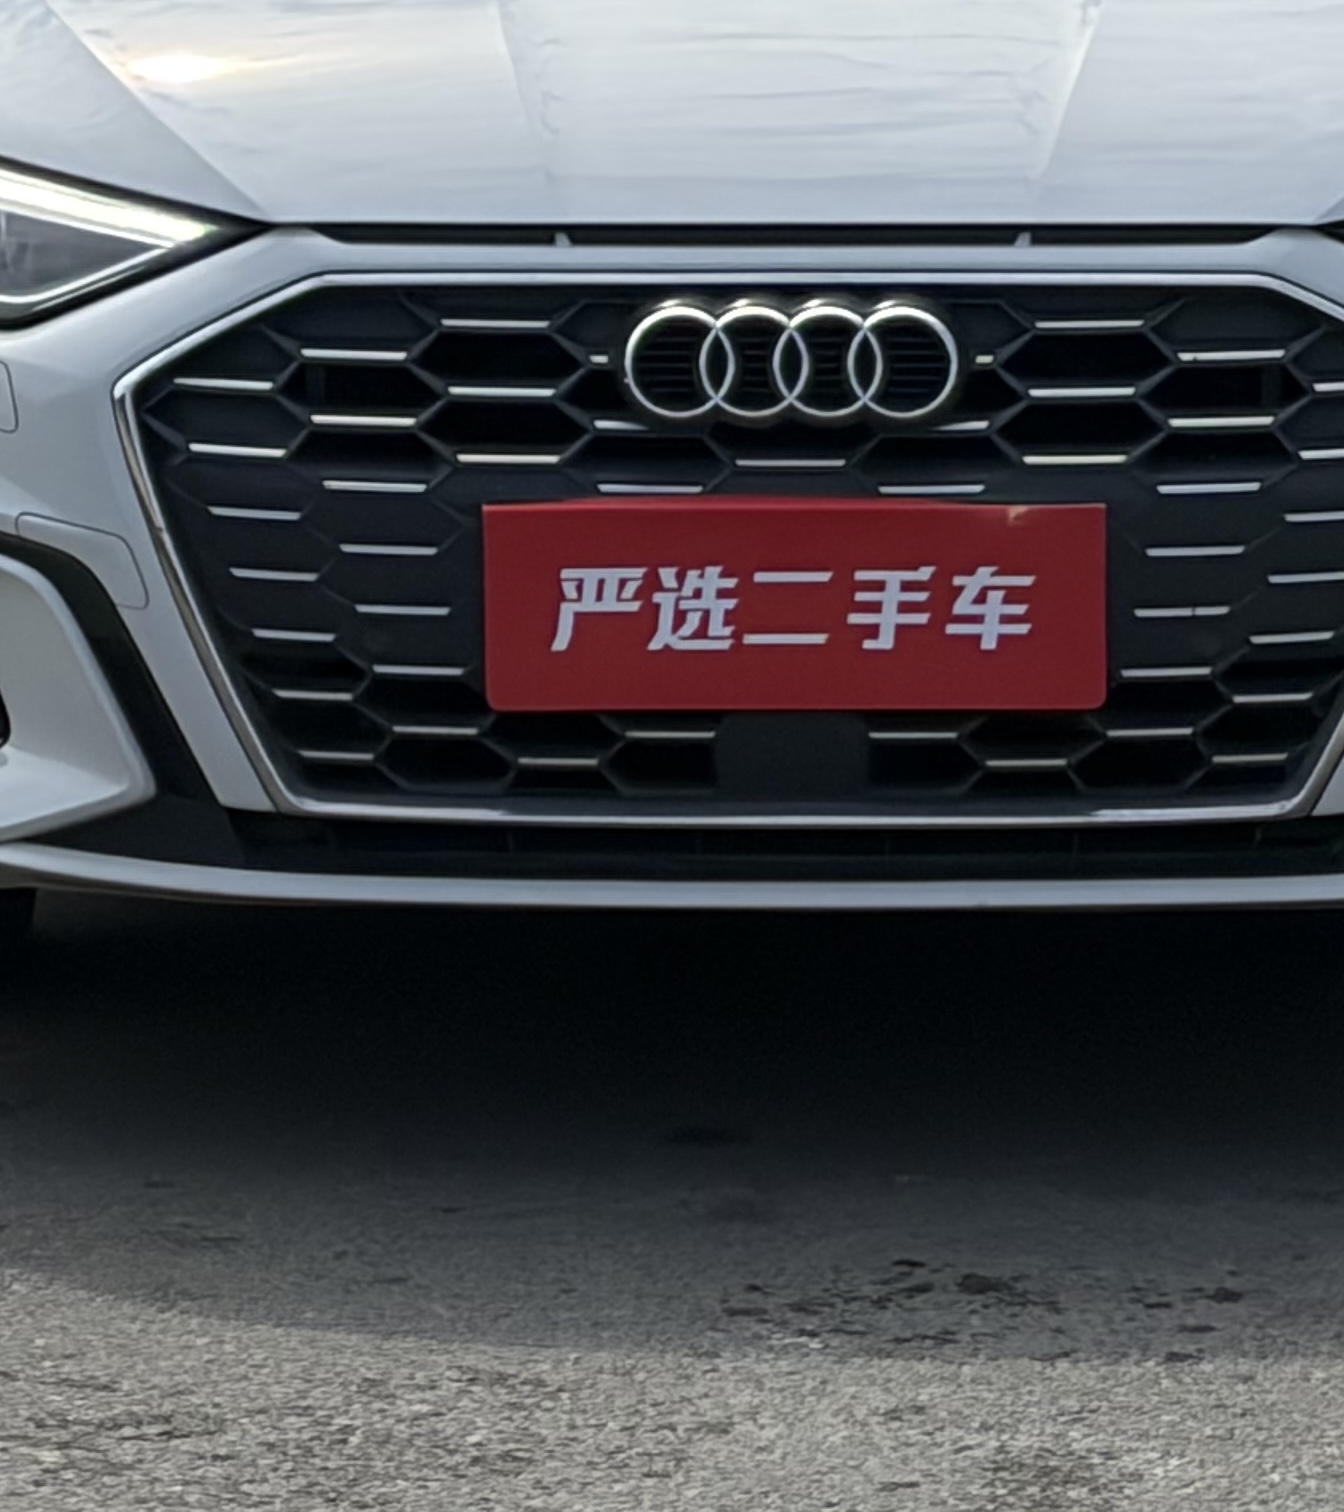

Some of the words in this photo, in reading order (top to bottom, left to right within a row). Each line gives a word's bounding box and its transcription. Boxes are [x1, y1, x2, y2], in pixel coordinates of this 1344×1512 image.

[550, 565, 1037, 651] 严选二手车
